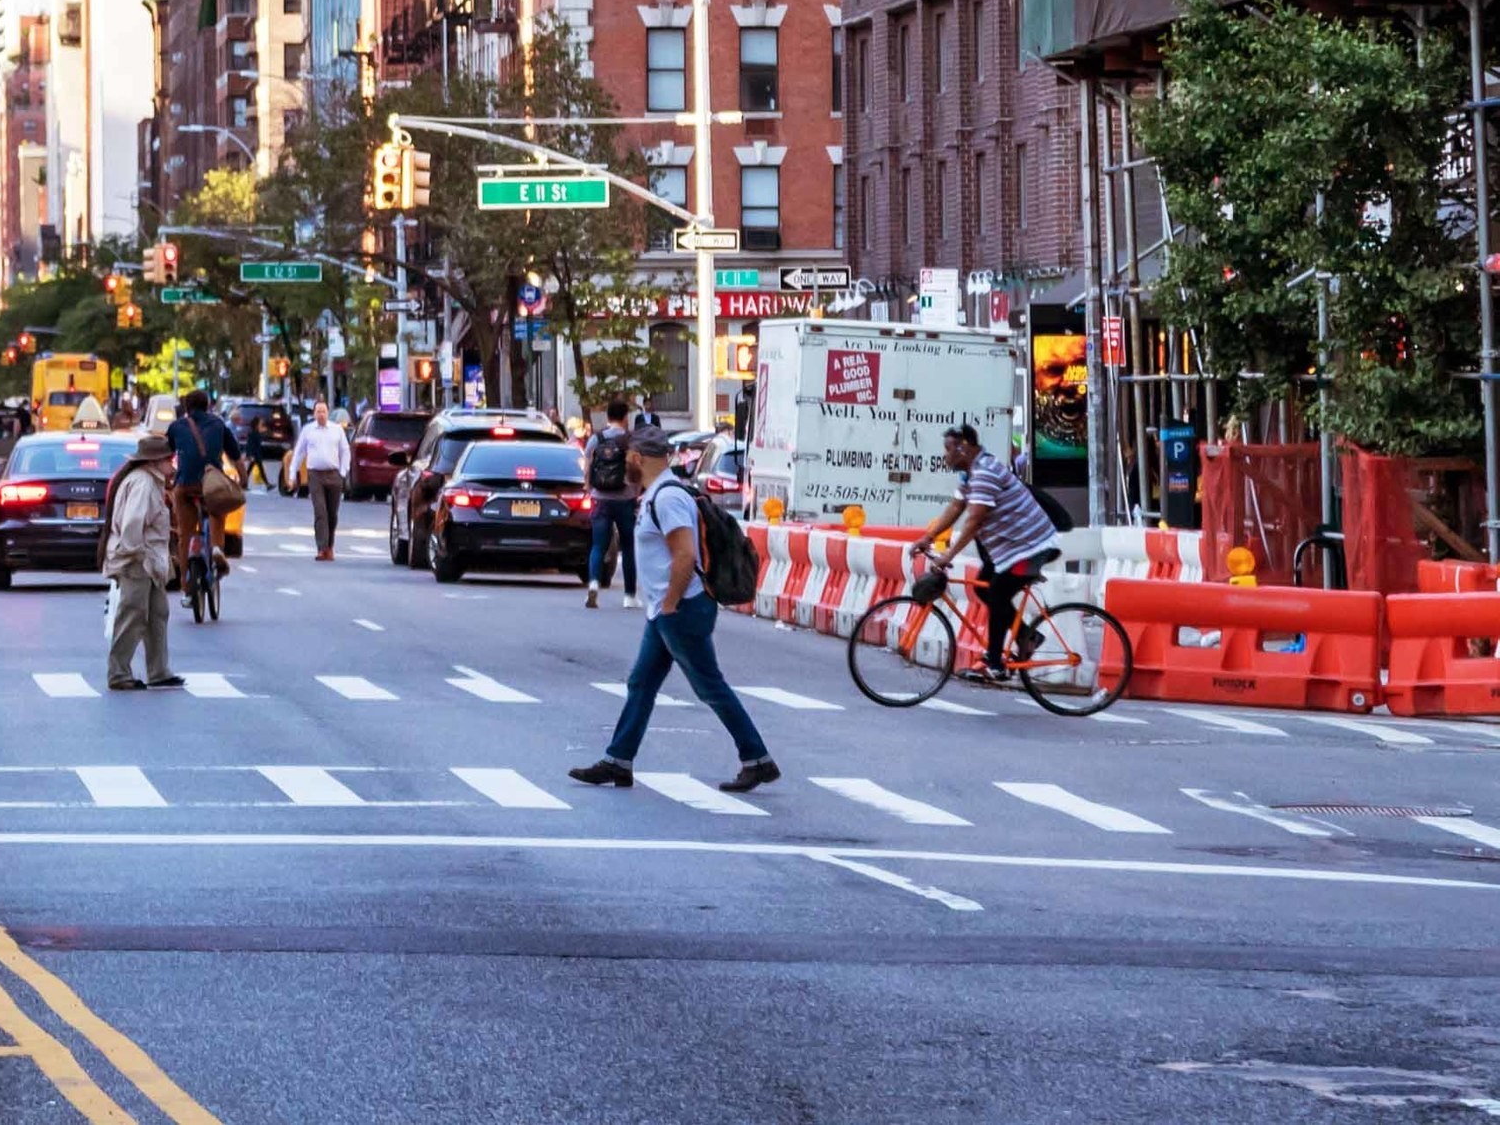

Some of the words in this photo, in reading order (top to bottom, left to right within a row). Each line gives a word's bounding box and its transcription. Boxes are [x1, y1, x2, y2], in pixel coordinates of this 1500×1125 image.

[519, 184, 529, 202] E
[536, 184, 545, 201] 11
[551, 183, 567, 201] St
[264, 267, 269, 276] E
[275, 267, 283, 276] 12
[823, 274, 842, 283] WAY
[843, 340, 863, 350] Are
[869, 341, 887, 351] You
[894, 342, 941, 356] Looking
[834, 358, 841, 370] A
[842, 353, 868, 368] REAL
[843, 365, 870, 379] GOOD
[828, 377, 873, 397] PLUMBER
[857, 390, 876, 403] INC.
[820, 403, 860, 418] Well,
[869, 406, 896, 421] You
[907, 408, 955, 425] Found
[1174, 442, 1185, 459] P
[826, 450, 872, 469] PLUMBING
[805, 483, 895, 503] 212-505-1837
